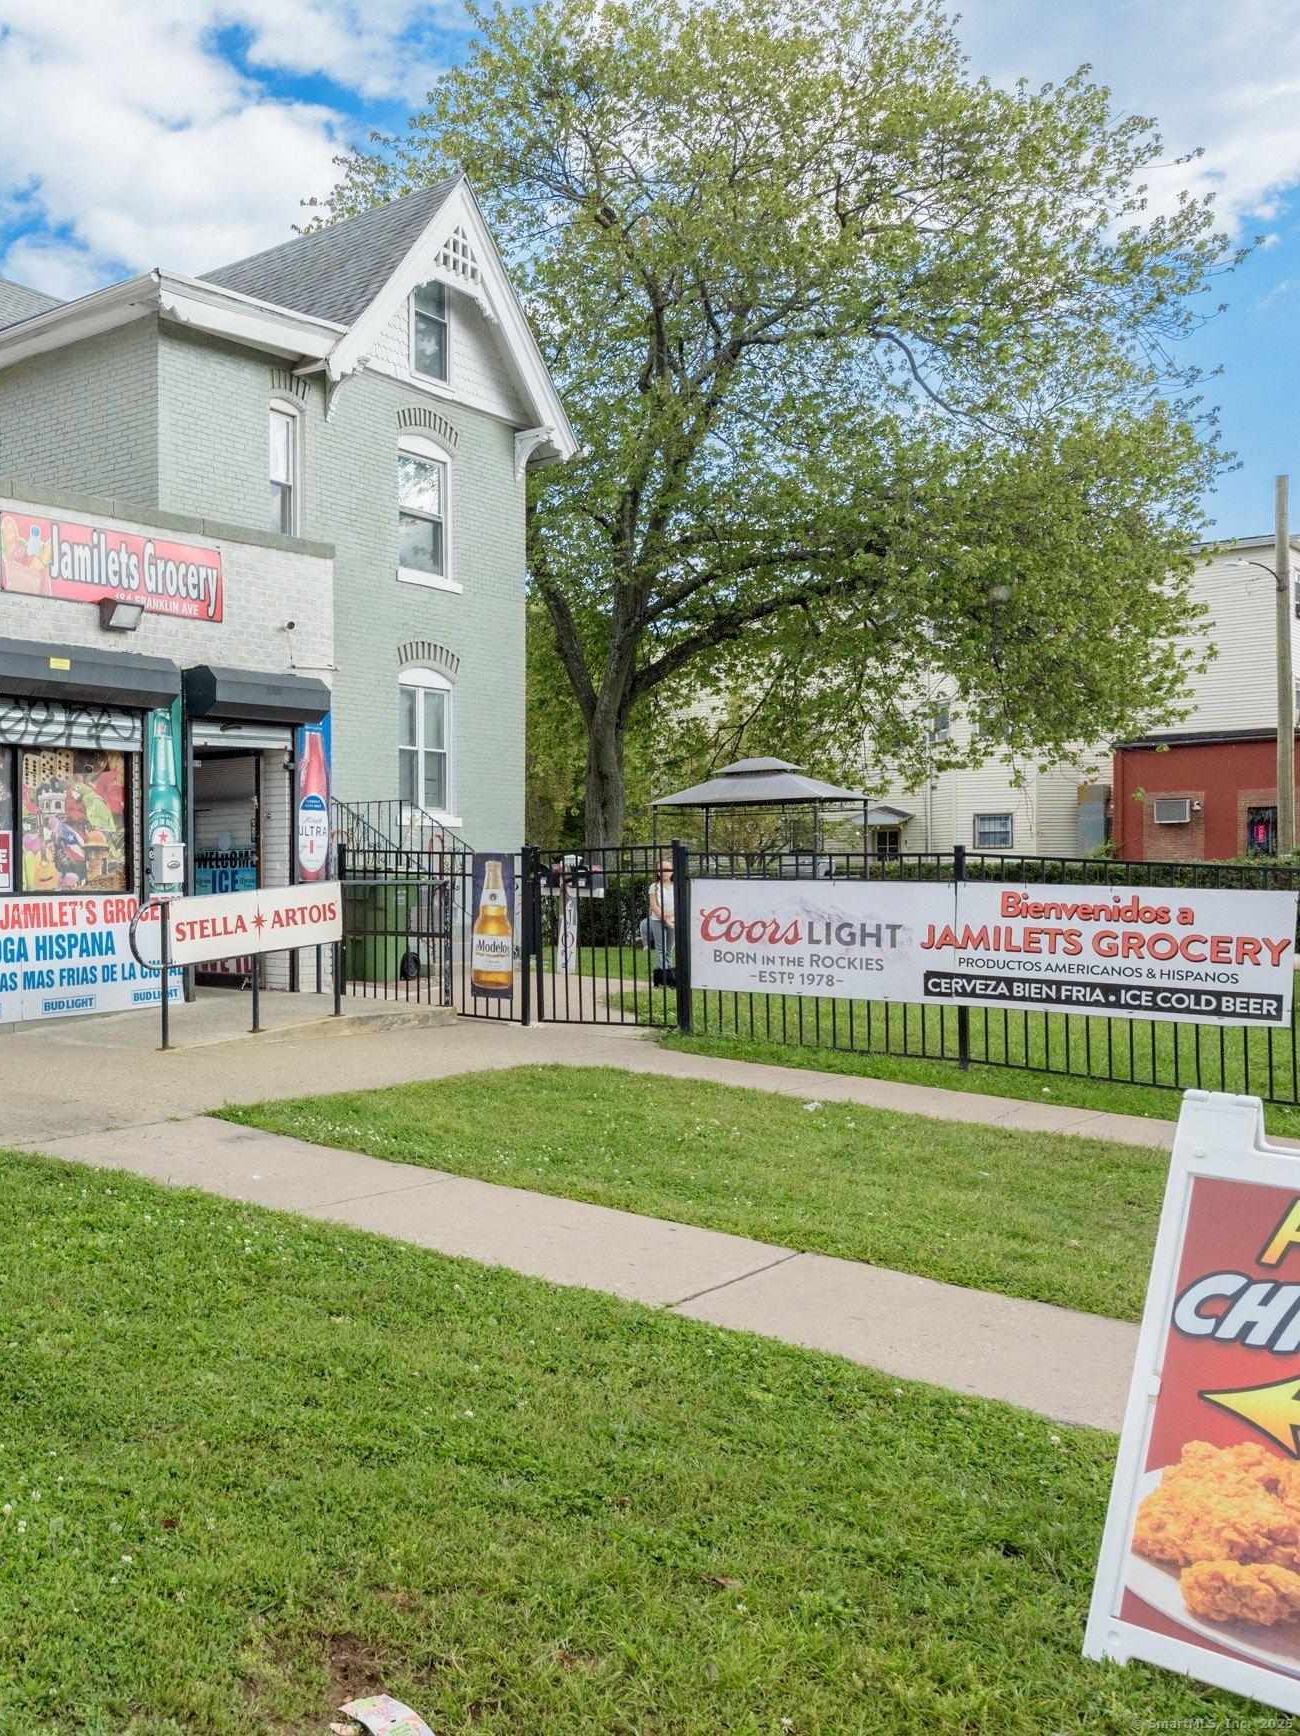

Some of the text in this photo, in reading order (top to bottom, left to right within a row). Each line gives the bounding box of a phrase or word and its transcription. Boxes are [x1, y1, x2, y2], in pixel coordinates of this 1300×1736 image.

[50, 523, 218, 618] Jamilets Grocery
[134, 595, 179, 613] FRANKLIN
[182, 604, 199, 616] AVE
[299, 826, 328, 837] ULTRA
[212, 870, 239, 894] ICE
[0, 900, 97, 930] JAMILET'S
[103, 896, 170, 924] GROE
[175, 902, 337, 942] STELLA ARTOIS
[1001, 891, 1194, 925] Bienvenidos a
[700, 906, 903, 949] Coors LIGHT
[35, 930, 115, 962] HISPANA
[478, 940, 507, 953] Modelo
[920, 924, 1292, 967] JAMILETS GROCERY
[713, 949, 884, 972] BORN IN THE ROCKIES
[958, 958, 1239, 984] PRODUCTOS AMERICANOS & HISPANOS
[22, 969, 54, 990] MAS
[59, 965, 97, 987] FRIAS
[102, 964, 118, 983] DE
[122, 962, 136, 980] LA
[44, 998, 94, 1012] BUD LIGHT
[134, 988, 179, 1002] BUD LIHT
[928, 977, 1278, 1016] CERVEZA BIEN FRIA ICE COLD BEER
